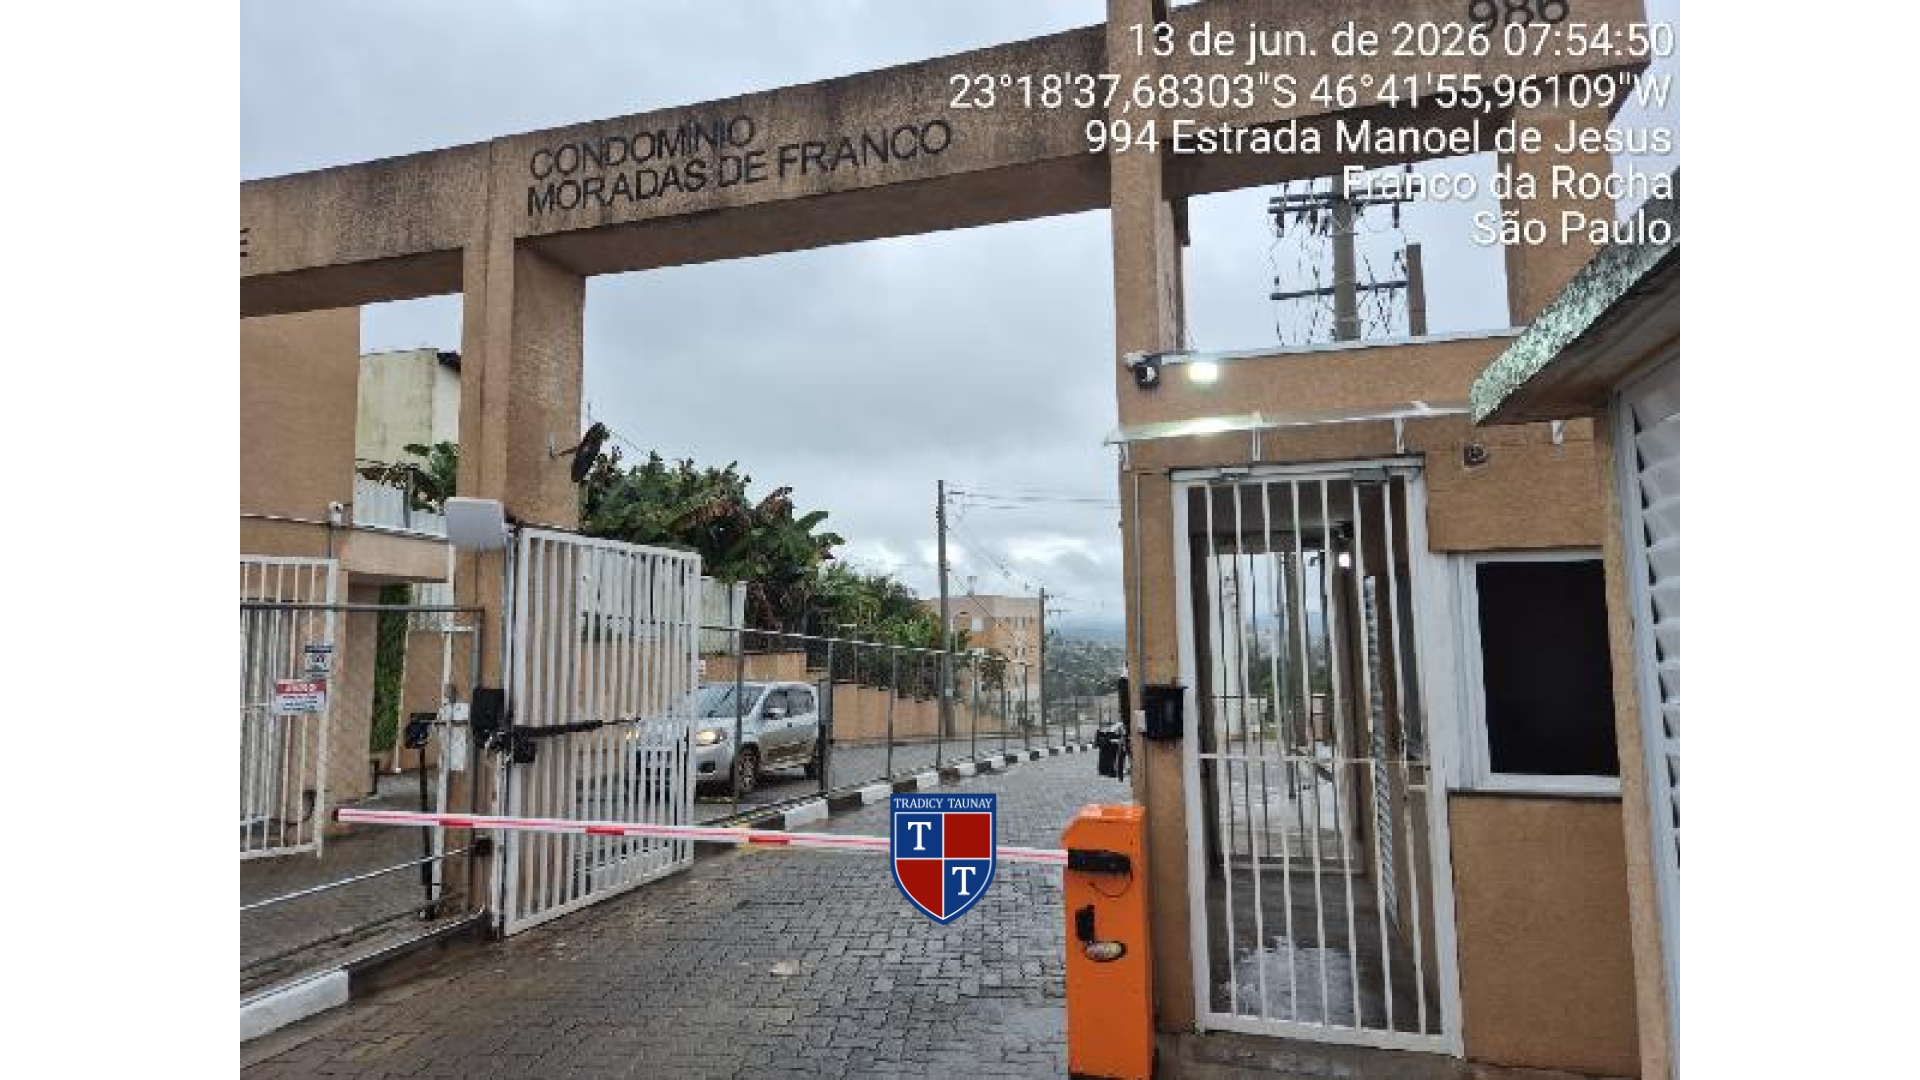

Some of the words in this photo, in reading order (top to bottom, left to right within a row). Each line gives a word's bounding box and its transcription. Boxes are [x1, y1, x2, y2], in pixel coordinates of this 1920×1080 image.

[527, 159, 707, 217] MORADAS
[718, 151, 768, 188] DE
[778, 119, 952, 179] FRANCO
